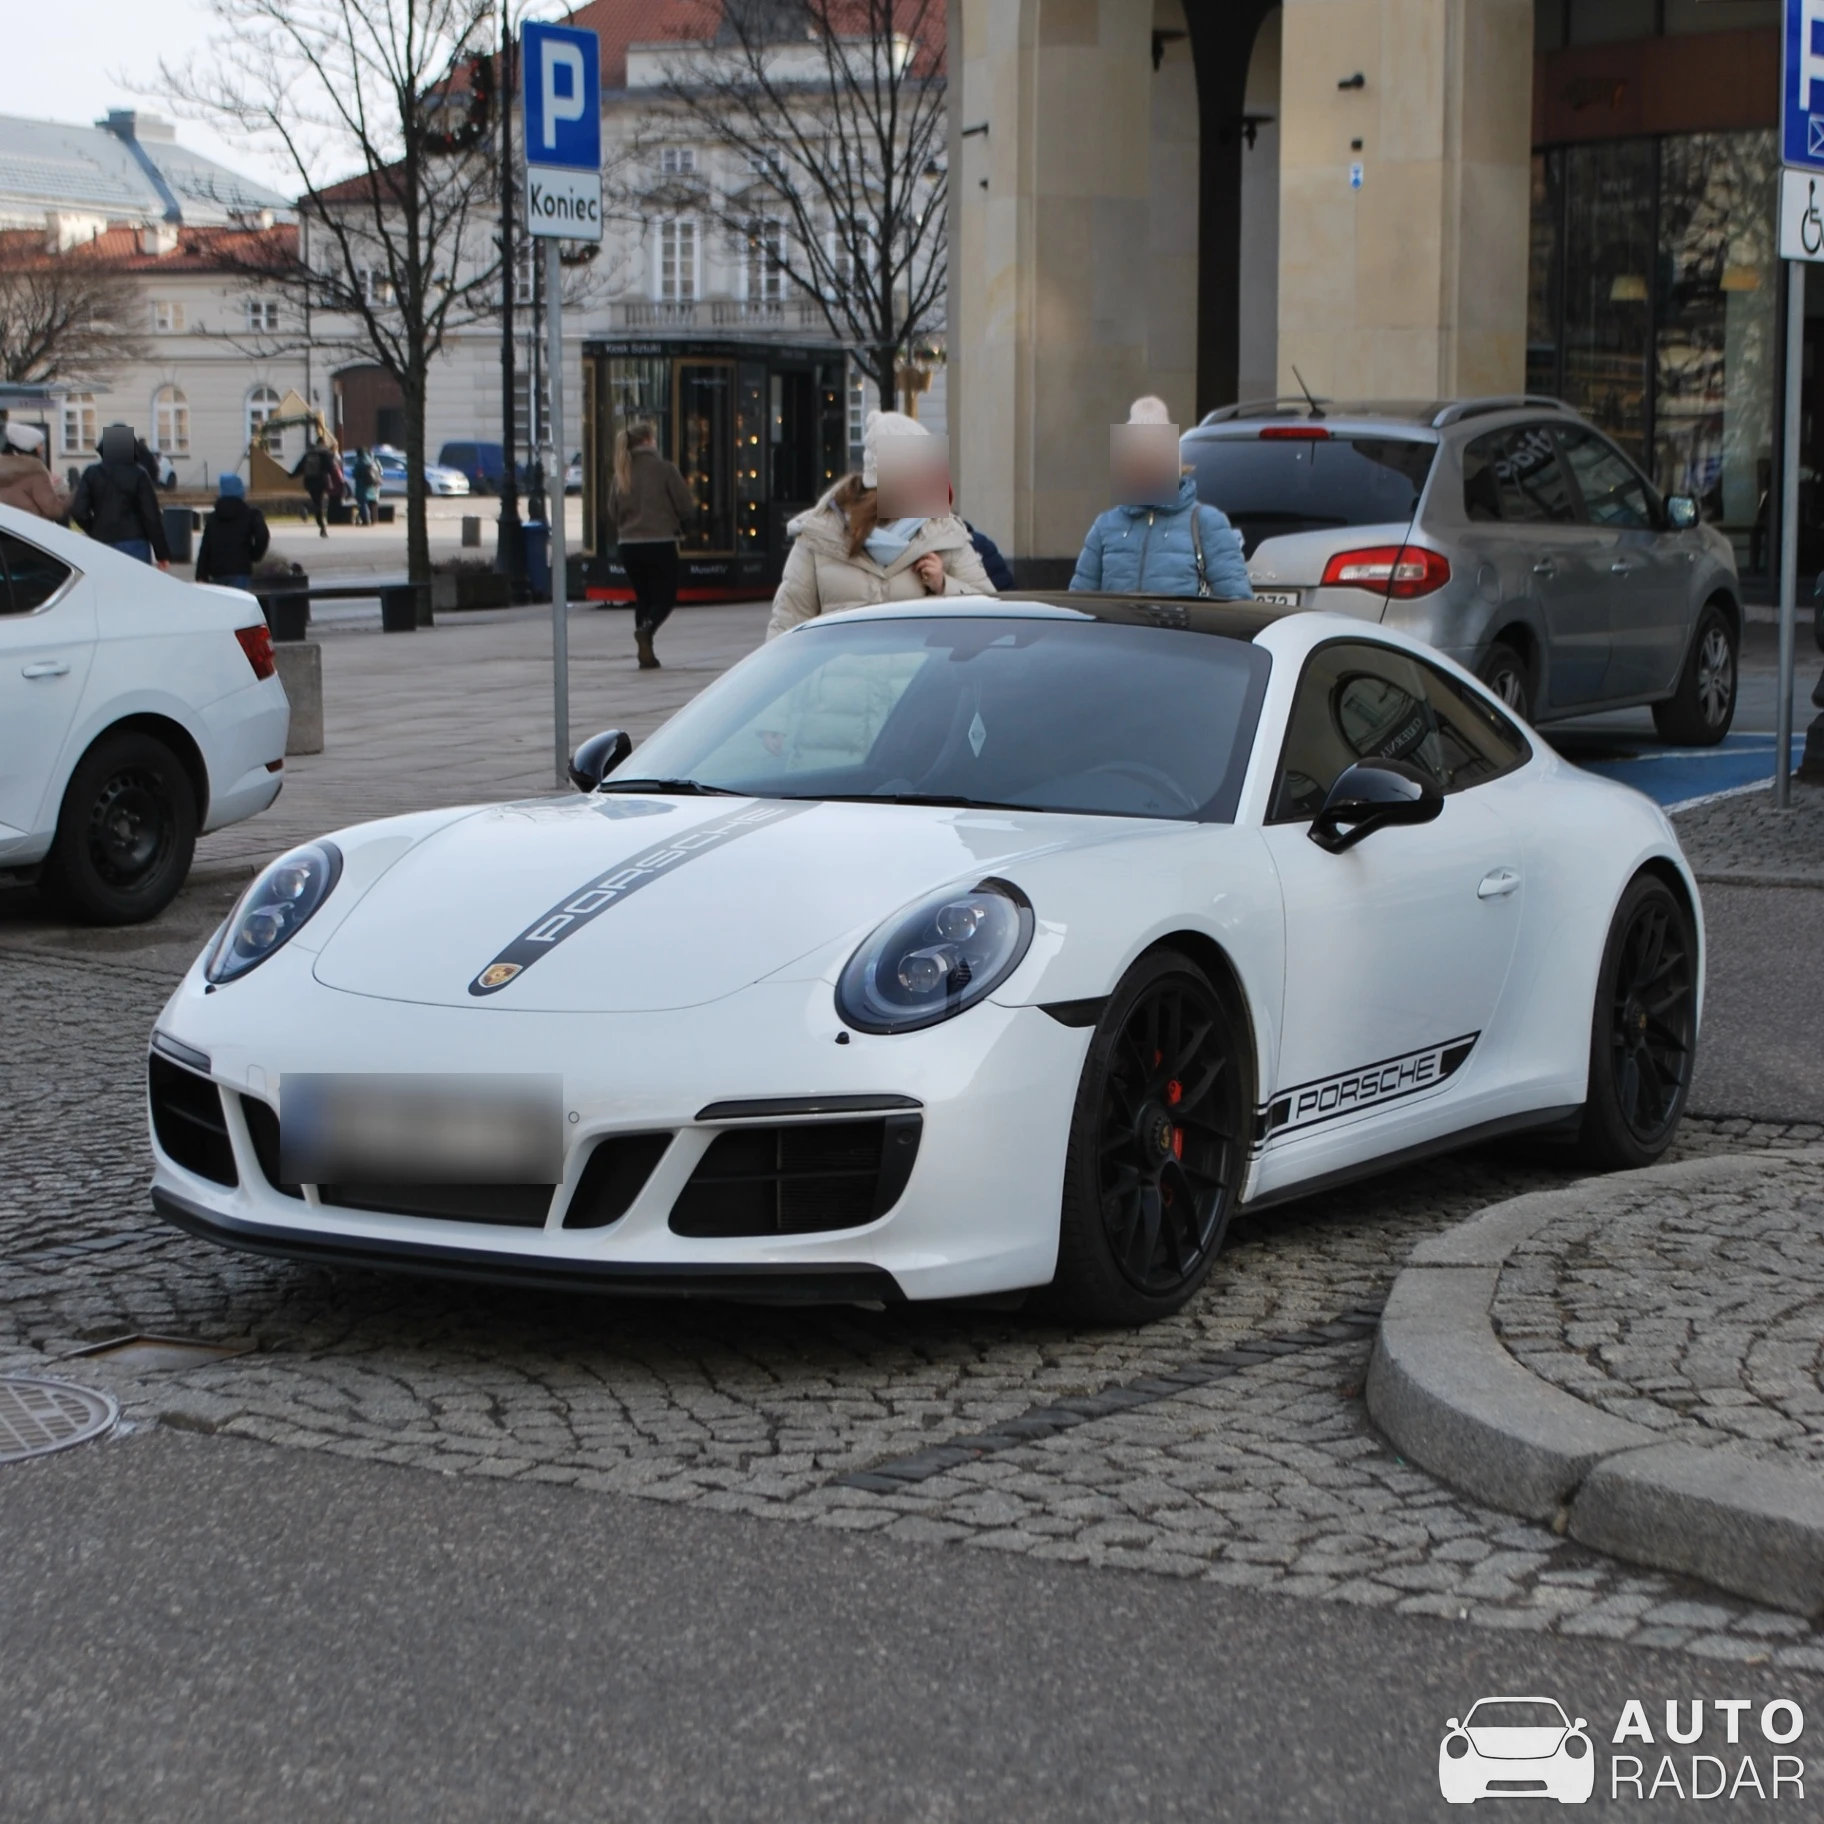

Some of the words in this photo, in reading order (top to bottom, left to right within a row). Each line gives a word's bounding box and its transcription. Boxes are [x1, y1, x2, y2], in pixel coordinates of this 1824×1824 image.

[541, 39, 585, 149] P
[530, 184, 598, 221] Koniec
[525, 806, 786, 942] PORSCHE
[1296, 1054, 1436, 1119] PORSCHE
